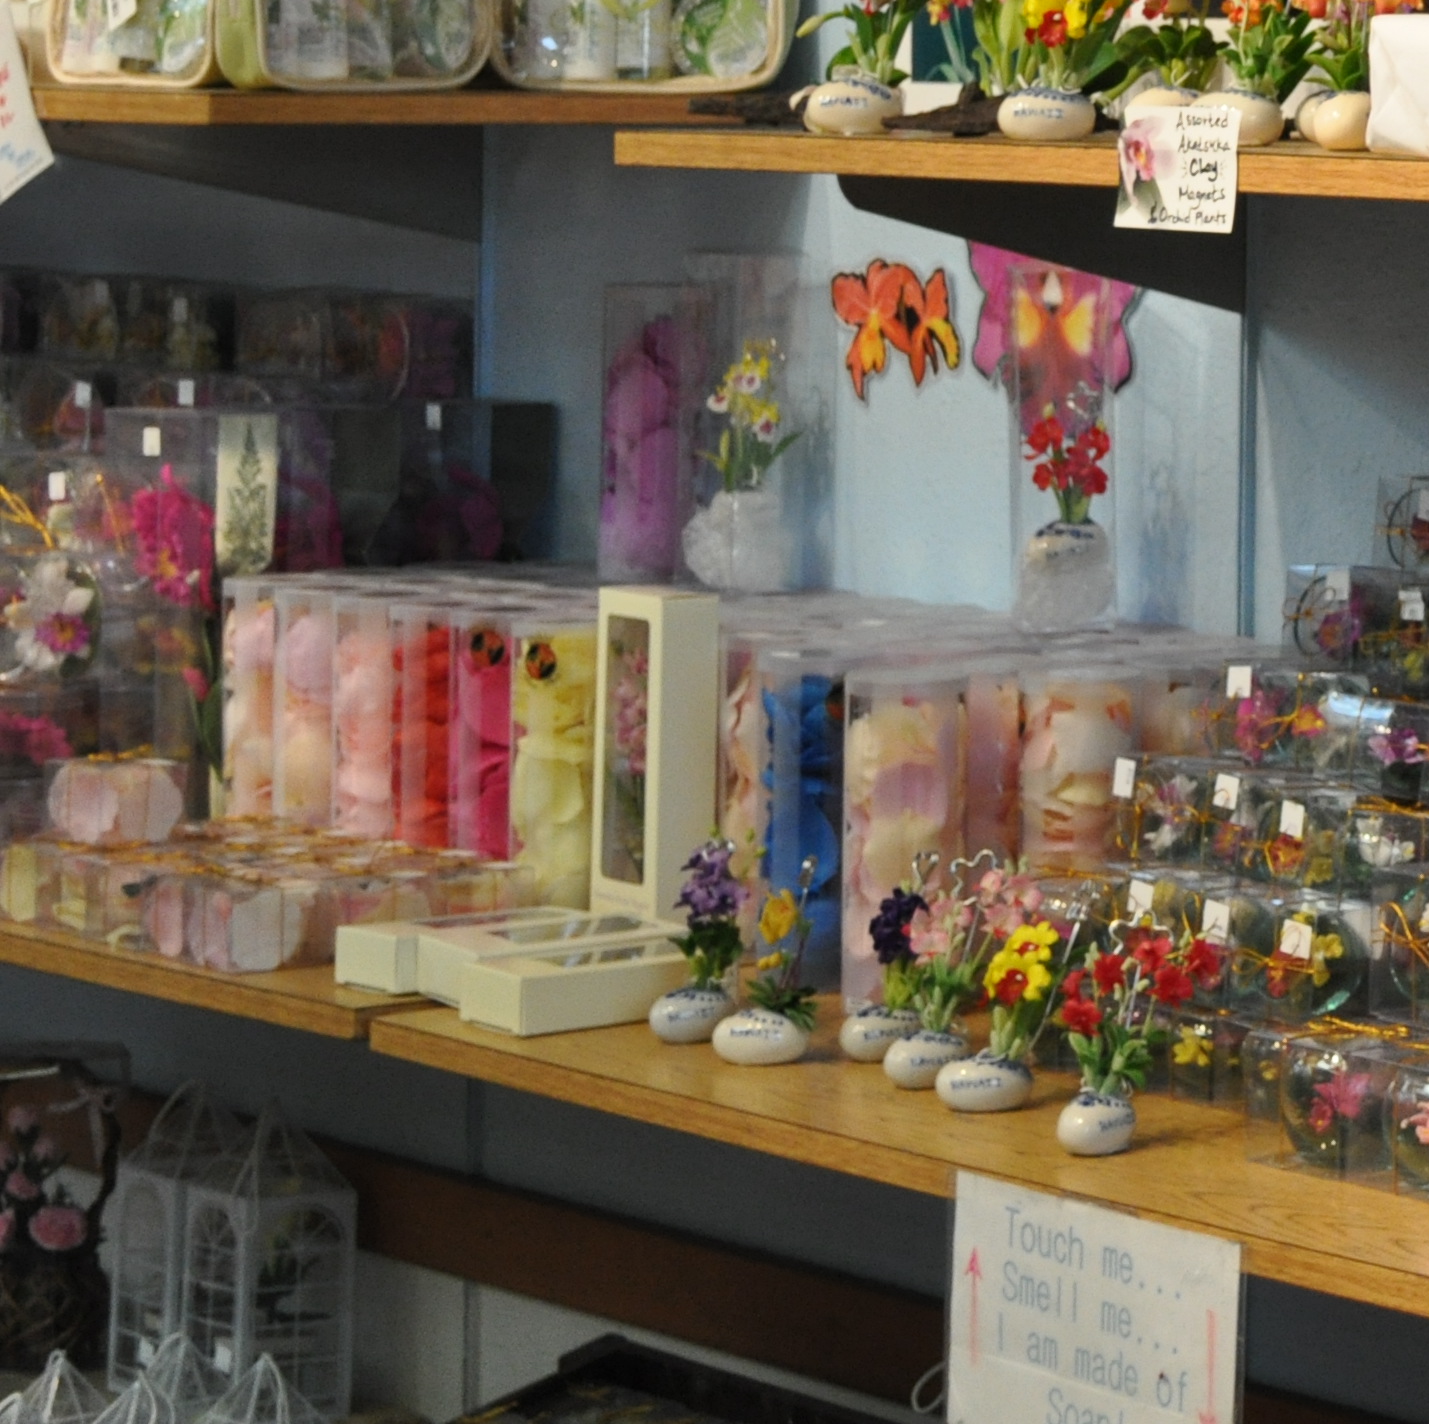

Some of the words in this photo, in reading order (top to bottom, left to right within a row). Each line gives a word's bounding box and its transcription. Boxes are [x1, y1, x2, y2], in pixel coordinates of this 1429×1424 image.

[1176, 110, 1230, 132] Assorted
[1159, 206, 1191, 224] Orchid
[1178, 186, 1227, 211] Magnets
[1004, 1205, 1085, 1271] Touch
[1002, 1259, 1079, 1324] Smell
[997, 1309, 1005, 1352] I
[1025, 1330, 1060, 1371] am
[1073, 1350, 1140, 1398] made
[1155, 1370, 1189, 1414] of
